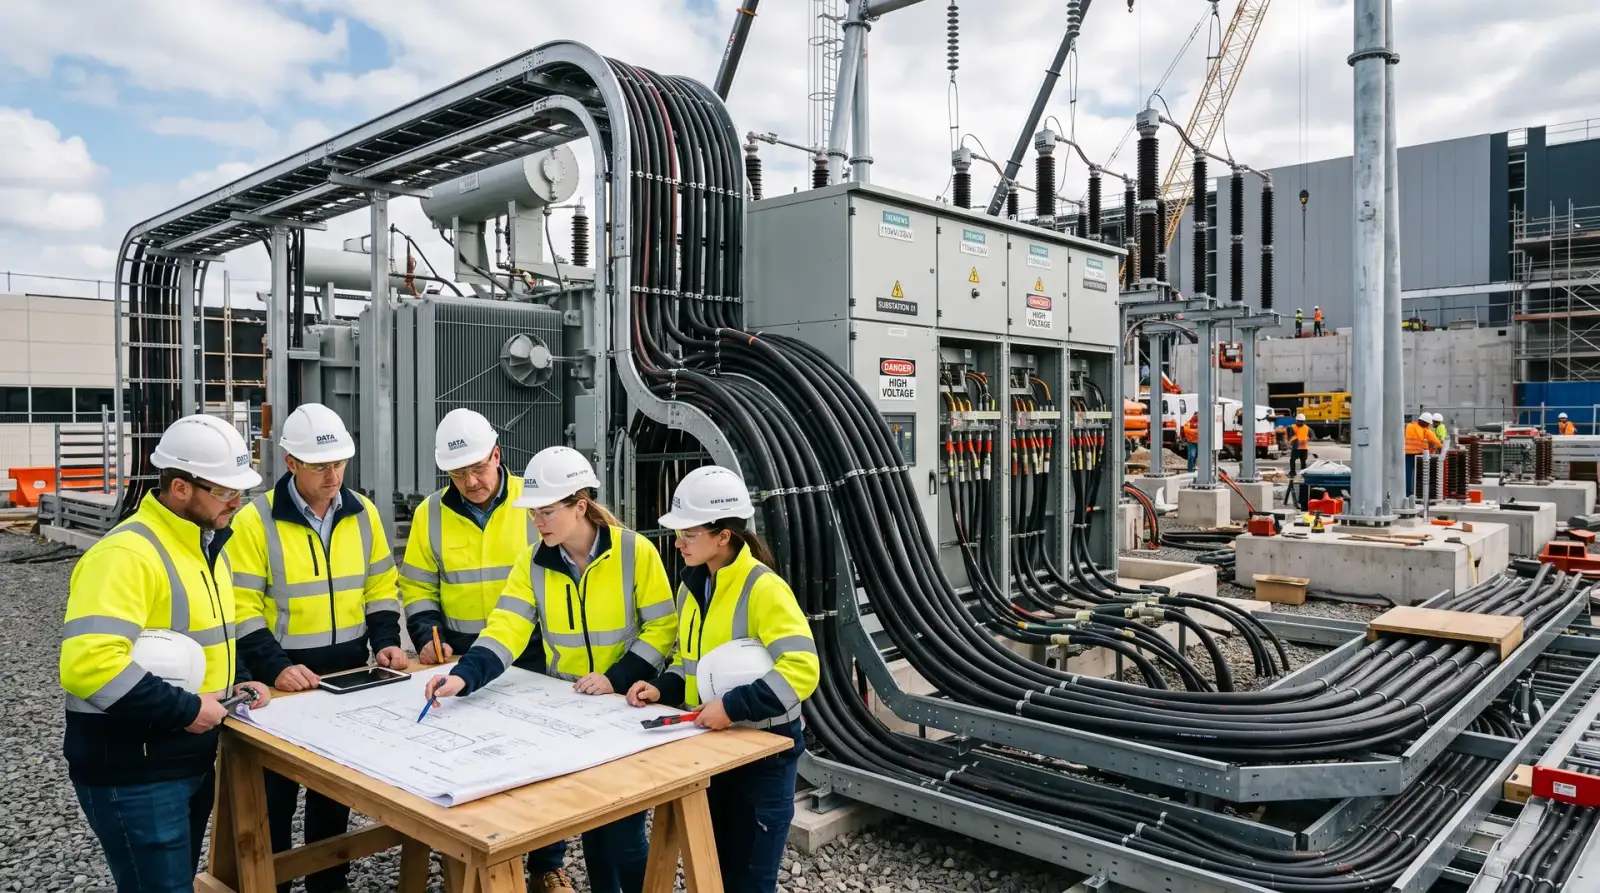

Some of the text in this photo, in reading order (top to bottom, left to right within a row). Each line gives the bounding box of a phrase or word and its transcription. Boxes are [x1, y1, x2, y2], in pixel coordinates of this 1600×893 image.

[878, 300, 909, 311] SUBSTATION
[1032, 311, 1046, 320] HIGH
[1028, 319, 1051, 329] VOLTAGE
[884, 363, 912, 373] DANGER
[889, 378, 907, 388] HIGH
[882, 388, 914, 398] VOLTAGE
[316, 434, 335, 442] DATA
[447, 439, 465, 448] DATA
